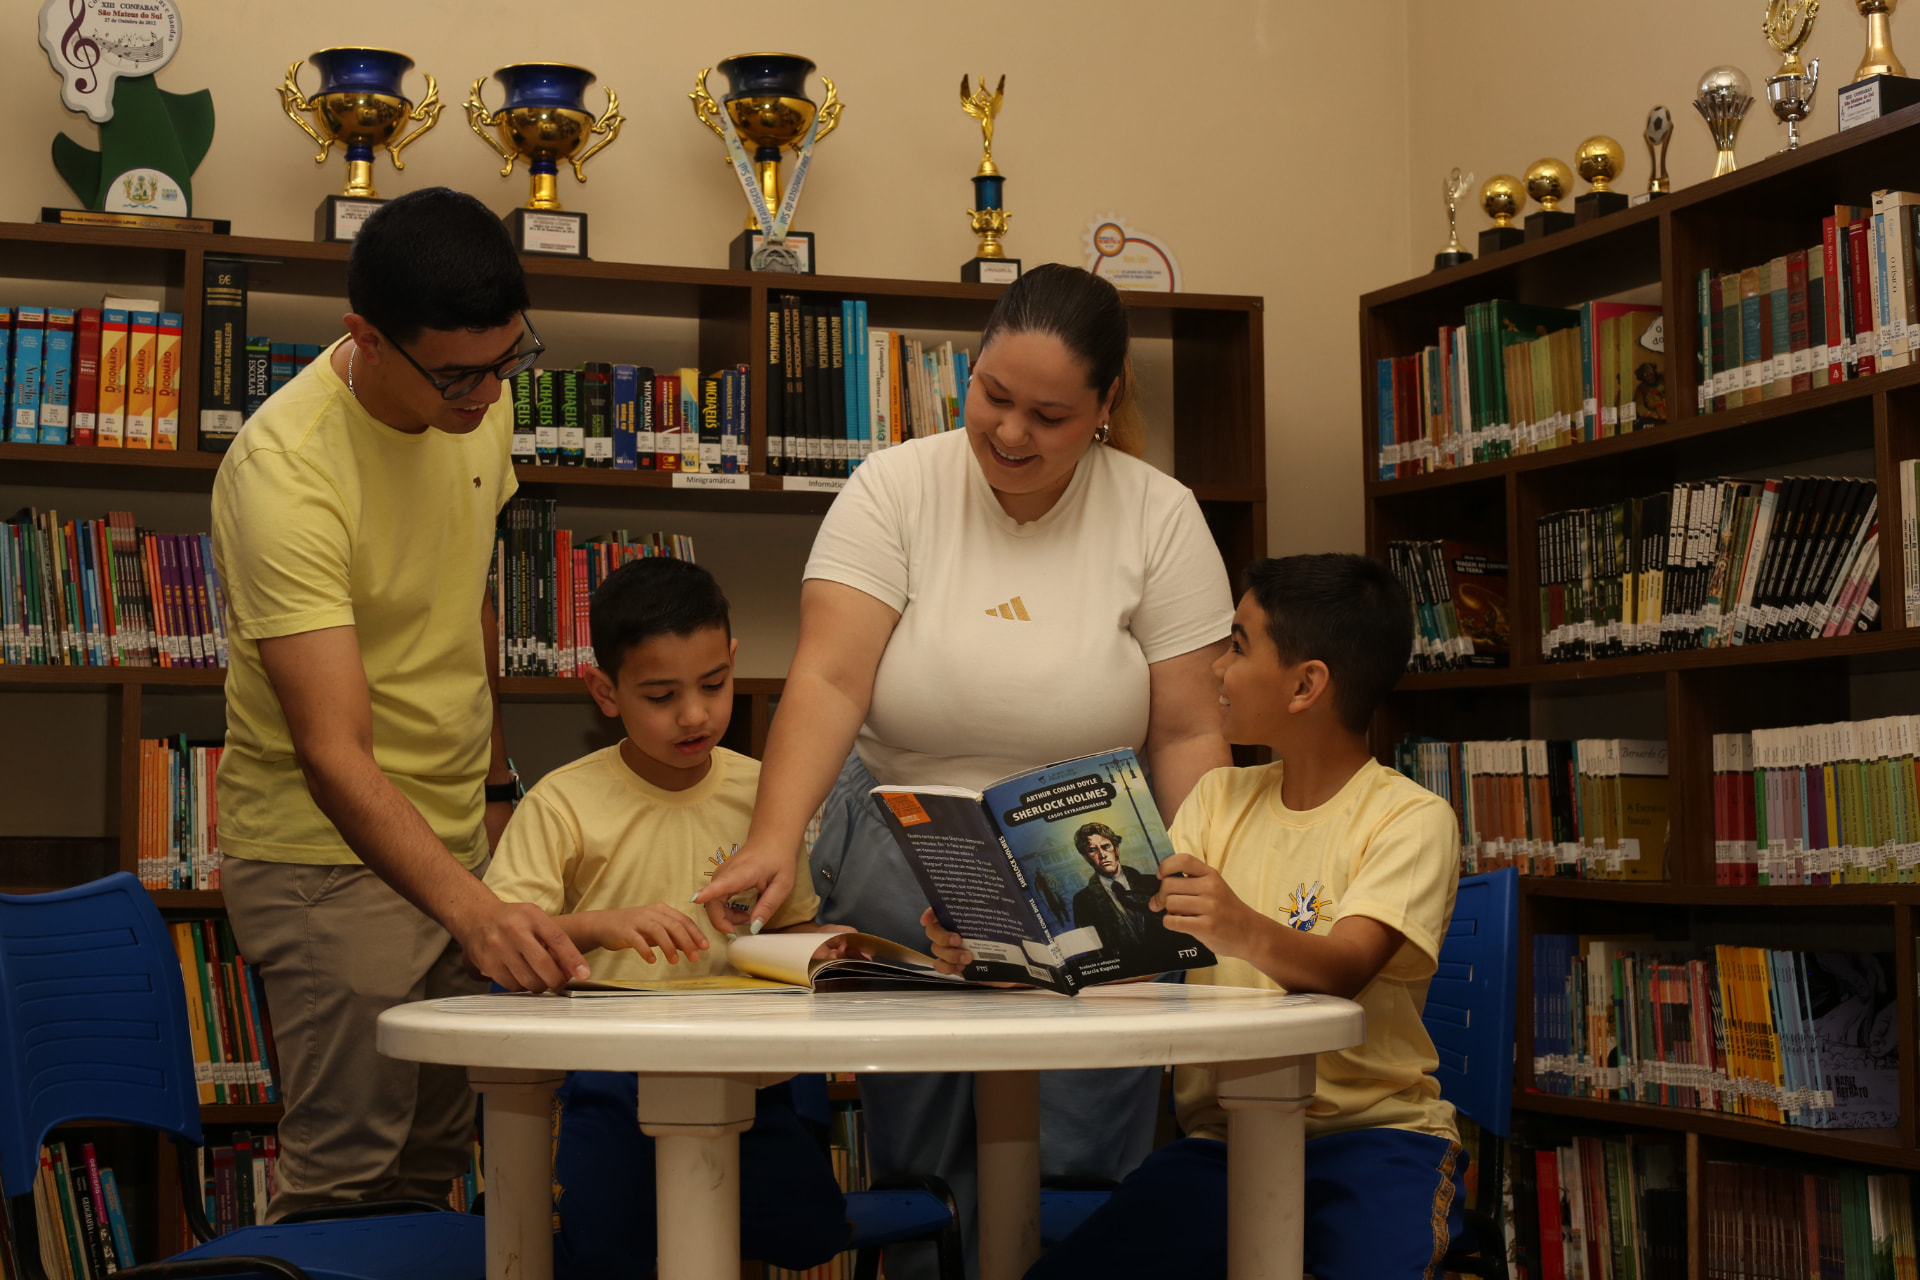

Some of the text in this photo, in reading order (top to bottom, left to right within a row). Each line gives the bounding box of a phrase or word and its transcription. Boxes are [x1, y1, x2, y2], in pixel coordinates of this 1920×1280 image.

[113, 10, 138, 18] Mateus
[878, 347, 886, 378] Computador
[248, 360, 256, 396] ESCOLAR
[257, 360, 268, 396] Oxford
[514, 370, 530, 425] MICHAELIS
[536, 371, 552, 426] MICHAELIS
[562, 373, 578, 428] MICHAELIS
[702, 380, 718, 429] MICHAELIS
[686, 476, 736, 486] Minigramática
[809, 480, 844, 489] Informátic
[1622, 747, 1657, 760] Bernardo
[1026, 778, 1098, 803] ARTHUR CONAN DOYLE
[1012, 788, 1108, 822] SHERLOCK HOLMES
[1047, 800, 1107, 820] CASOS EXTRAORDINÁRIOS
[998, 835, 1014, 862] HOLMES
[1010, 859, 1028, 888] SHERLOCK
[1029, 898, 1039, 913] DOYLE
[1036, 912, 1047, 930] CONAN
[1177, 947, 1198, 959] FTD
[1065, 974, 1075, 988] FTD
[1834, 1075, 1856, 1087] NARIZ
[1836, 1087, 1868, 1099] RETRATO
